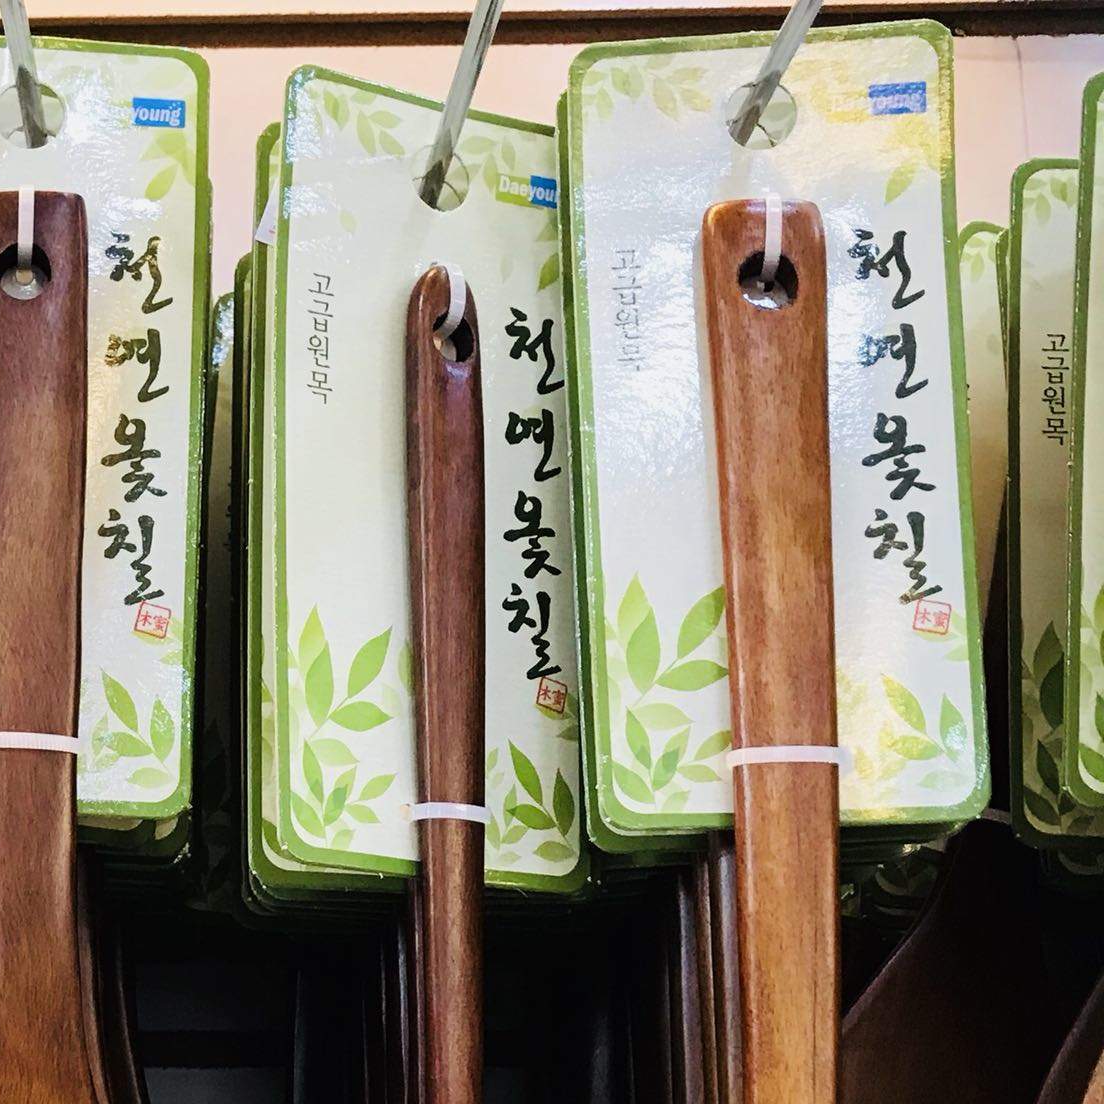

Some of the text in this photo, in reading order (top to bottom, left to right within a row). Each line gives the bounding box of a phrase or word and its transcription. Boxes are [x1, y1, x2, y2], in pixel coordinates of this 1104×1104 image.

[112, 103, 181, 126] young
[499, 175, 560, 203] Daeyou
[307, 272, 335, 405] 고급원목
[1041, 333, 1070, 446] 고급원목
